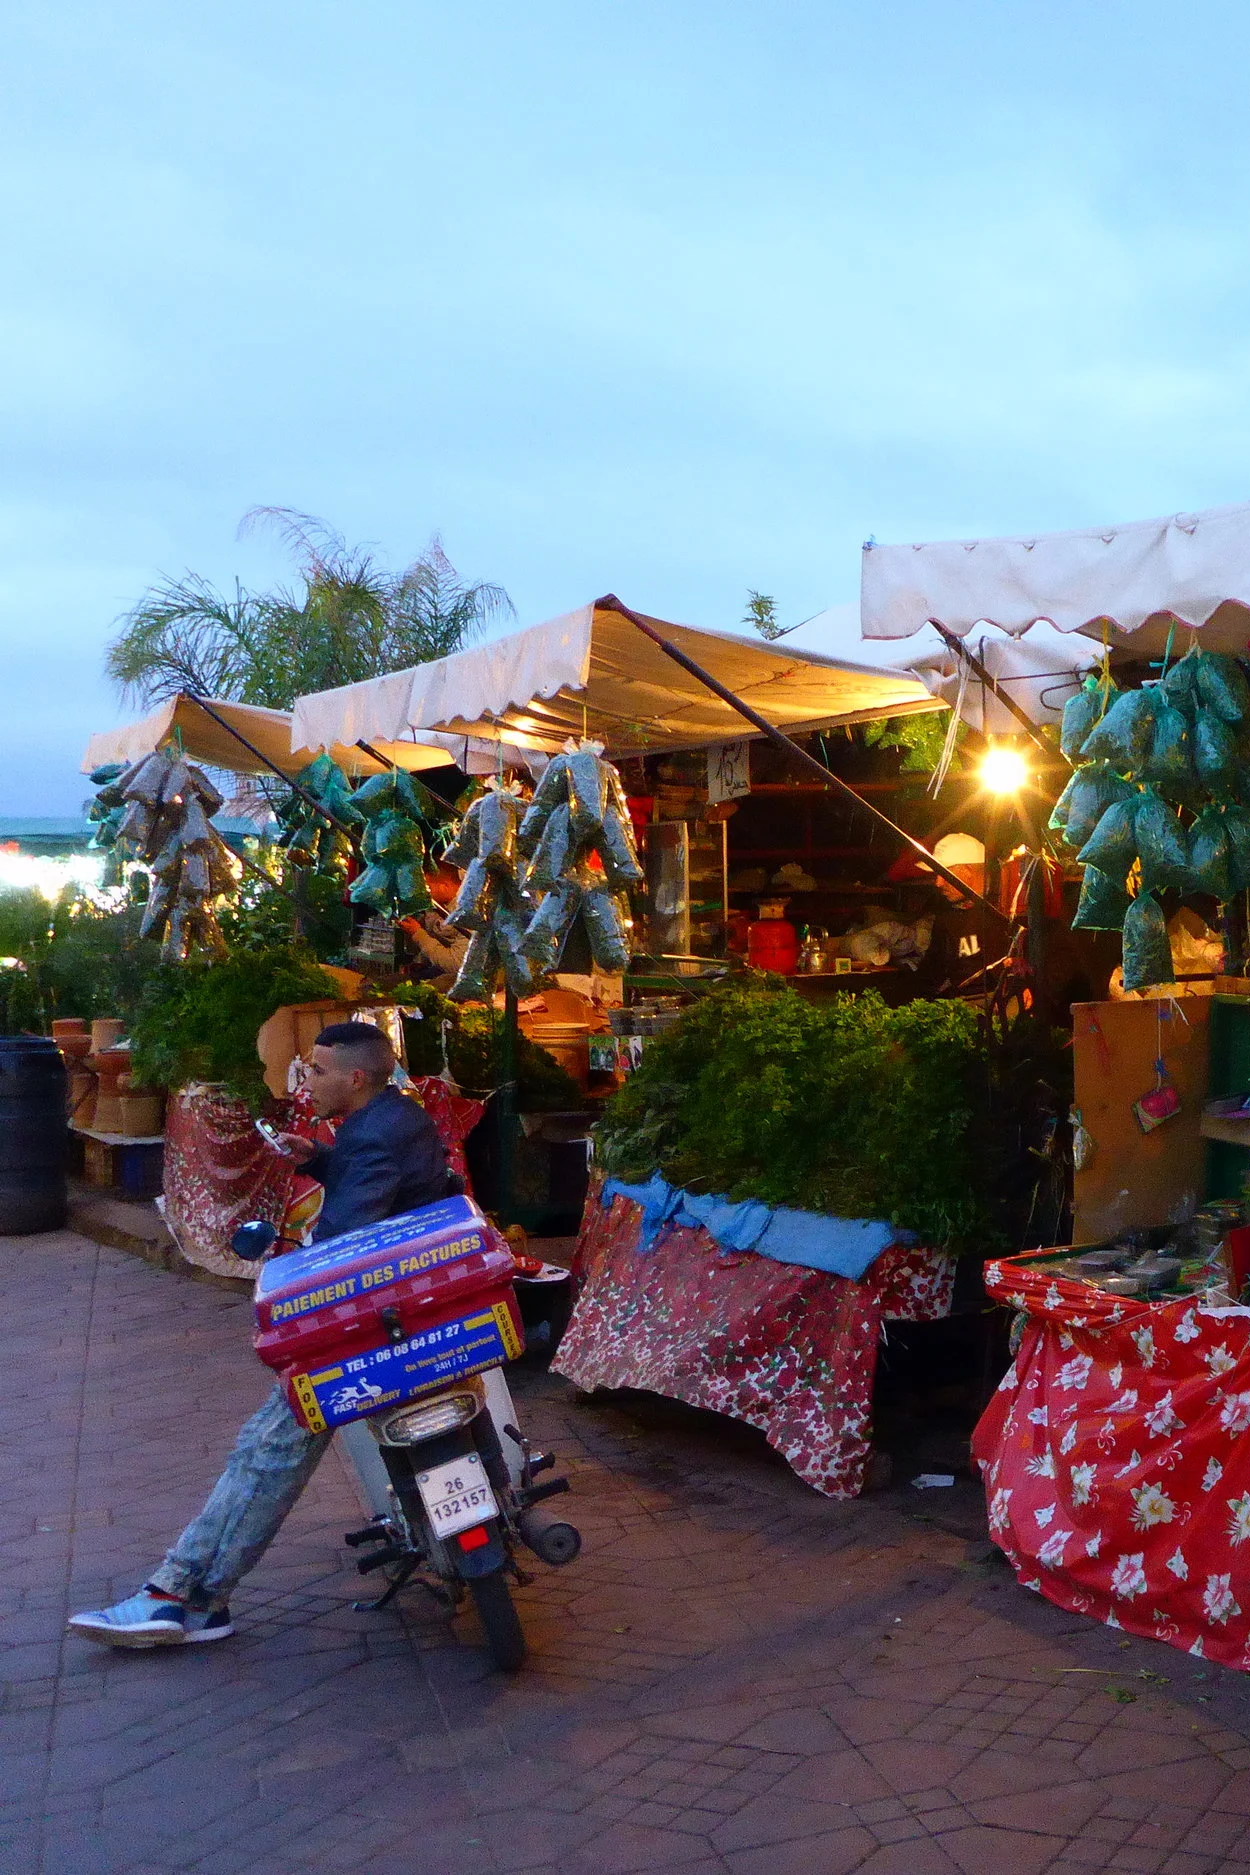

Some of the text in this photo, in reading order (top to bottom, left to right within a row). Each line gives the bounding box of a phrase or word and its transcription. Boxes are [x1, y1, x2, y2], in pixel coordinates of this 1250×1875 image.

[271, 1278, 356, 1321] PAIEMENT
[361, 1265, 394, 1289] DES
[399, 1234, 481, 1276] FACTURES
[346, 1358, 368, 1373] TEL
[376, 1349, 391, 1363] 06
[445, 1323, 460, 1339] 27
[333, 1397, 358, 1416] FAST
[445, 1477, 464, 1495] 26
[434, 1488, 487, 1520] 132157
